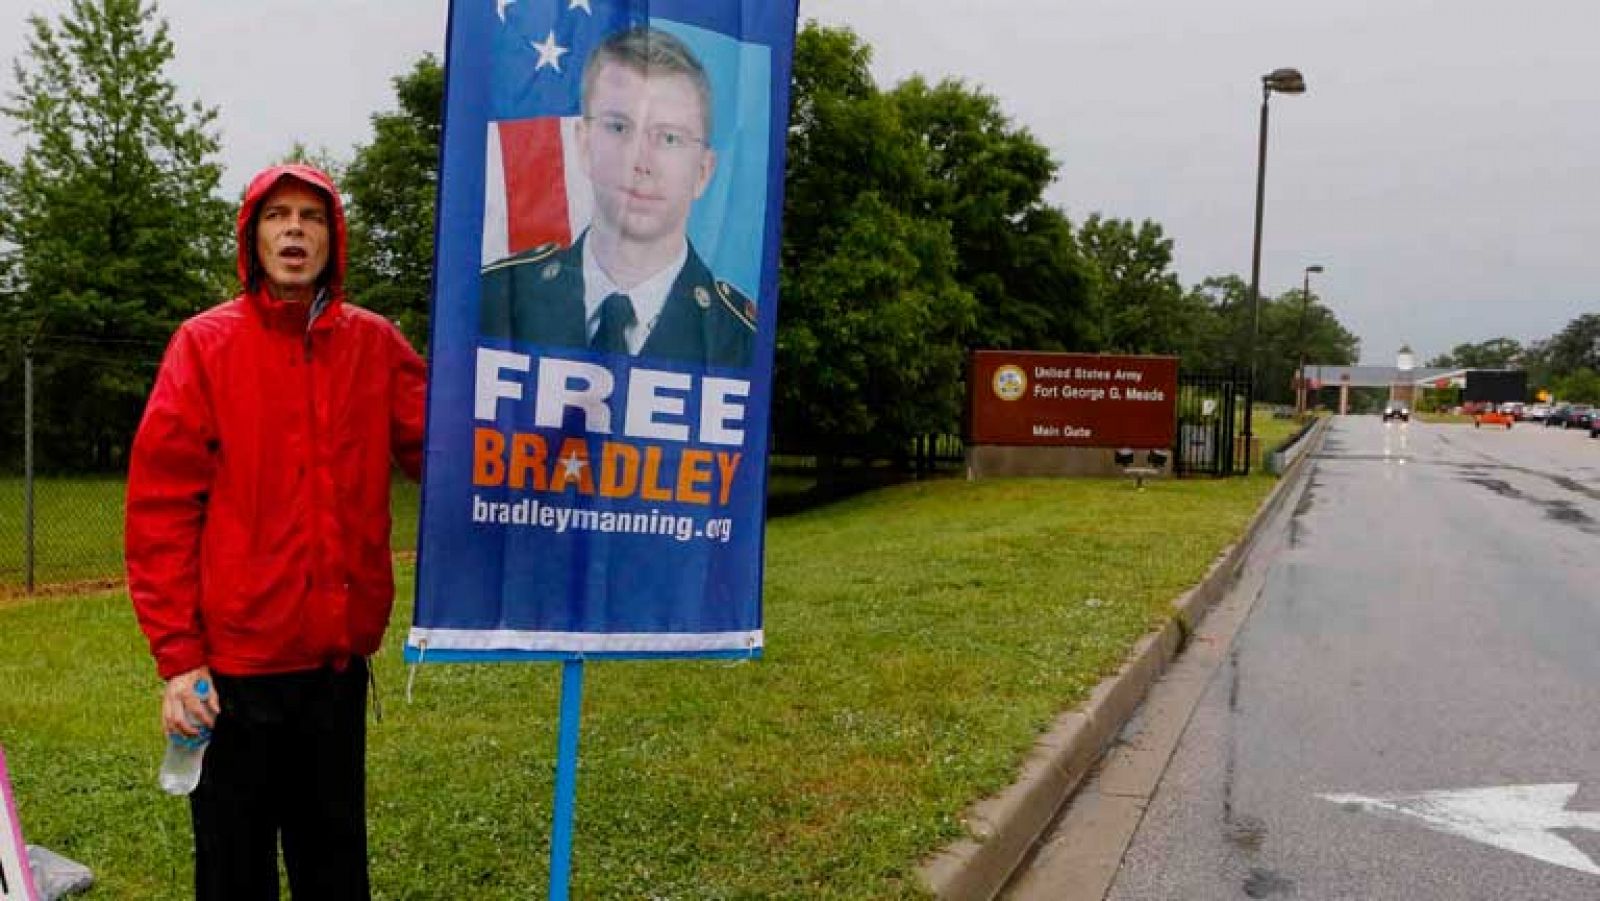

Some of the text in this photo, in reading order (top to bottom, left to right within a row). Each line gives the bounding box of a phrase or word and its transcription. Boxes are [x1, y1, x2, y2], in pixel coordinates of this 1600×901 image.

[1034, 367, 1143, 382] United States Army
[474, 347, 751, 445] FREE
[1033, 384, 1058, 397] Fort
[1062, 386, 1105, 401] George
[1126, 388, 1165, 401] Meade
[1033, 425, 1092, 438] Main Gate
[472, 427, 742, 506] BRADLEY
